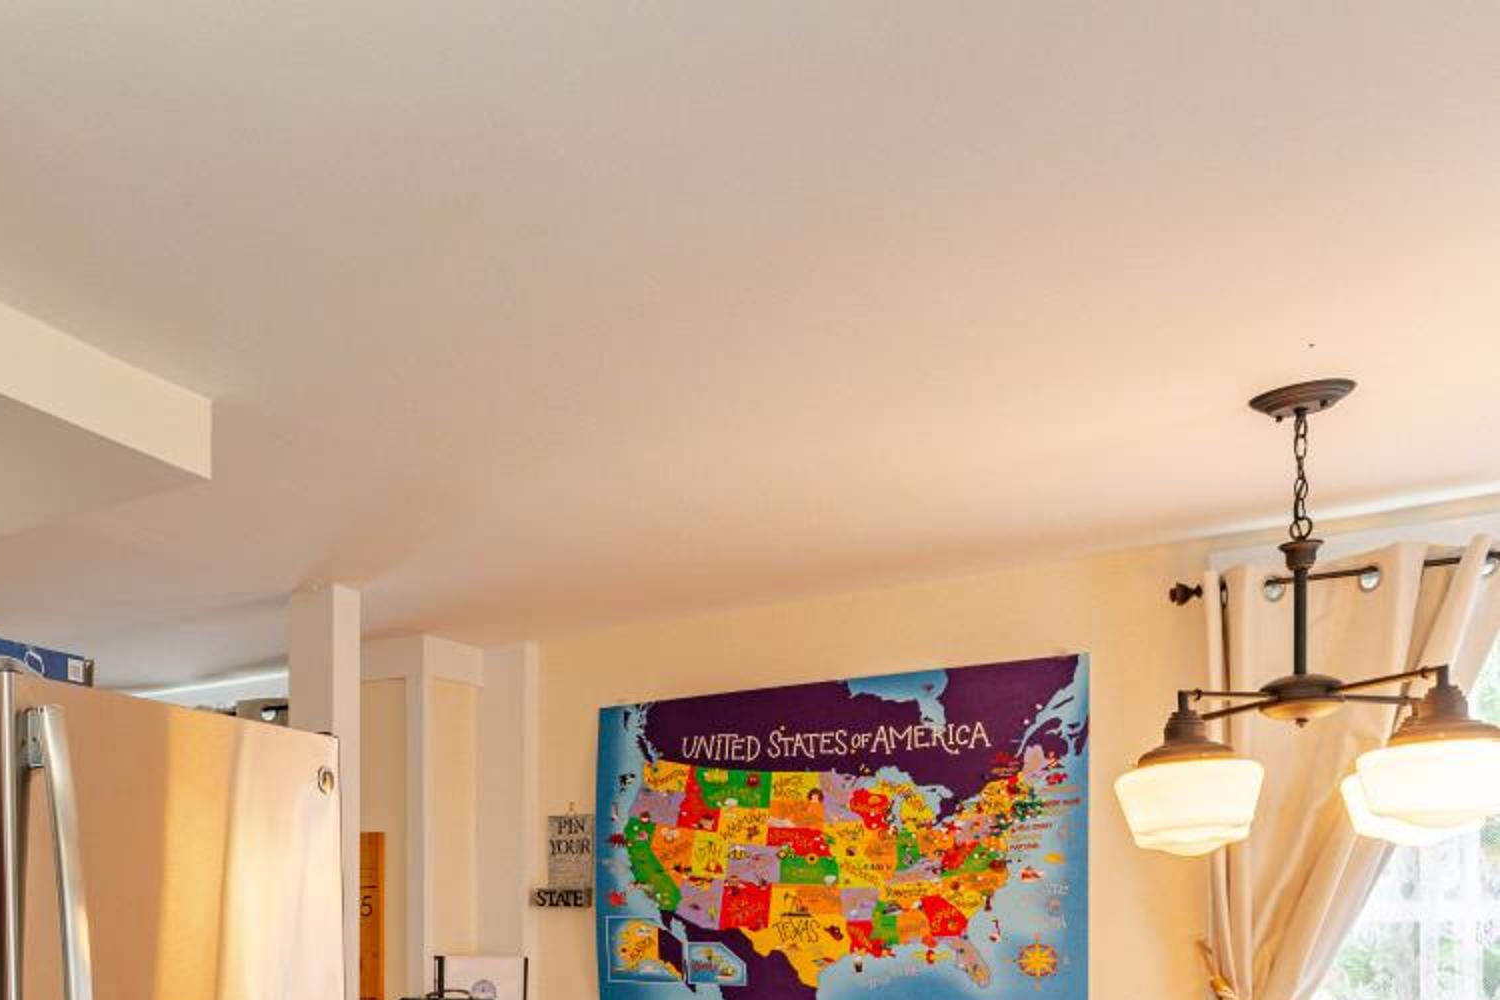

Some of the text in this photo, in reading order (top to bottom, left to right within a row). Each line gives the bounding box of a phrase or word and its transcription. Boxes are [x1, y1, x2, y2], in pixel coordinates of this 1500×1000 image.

[682, 734, 761, 761] UNITED
[767, 728, 849, 757] STATES
[870, 721, 991, 754] AMERICA
[557, 817, 585, 835] PIN
[549, 838, 591, 856] YOUR
[535, 888, 584, 907] STATE
[772, 919, 820, 942] TEXAS
